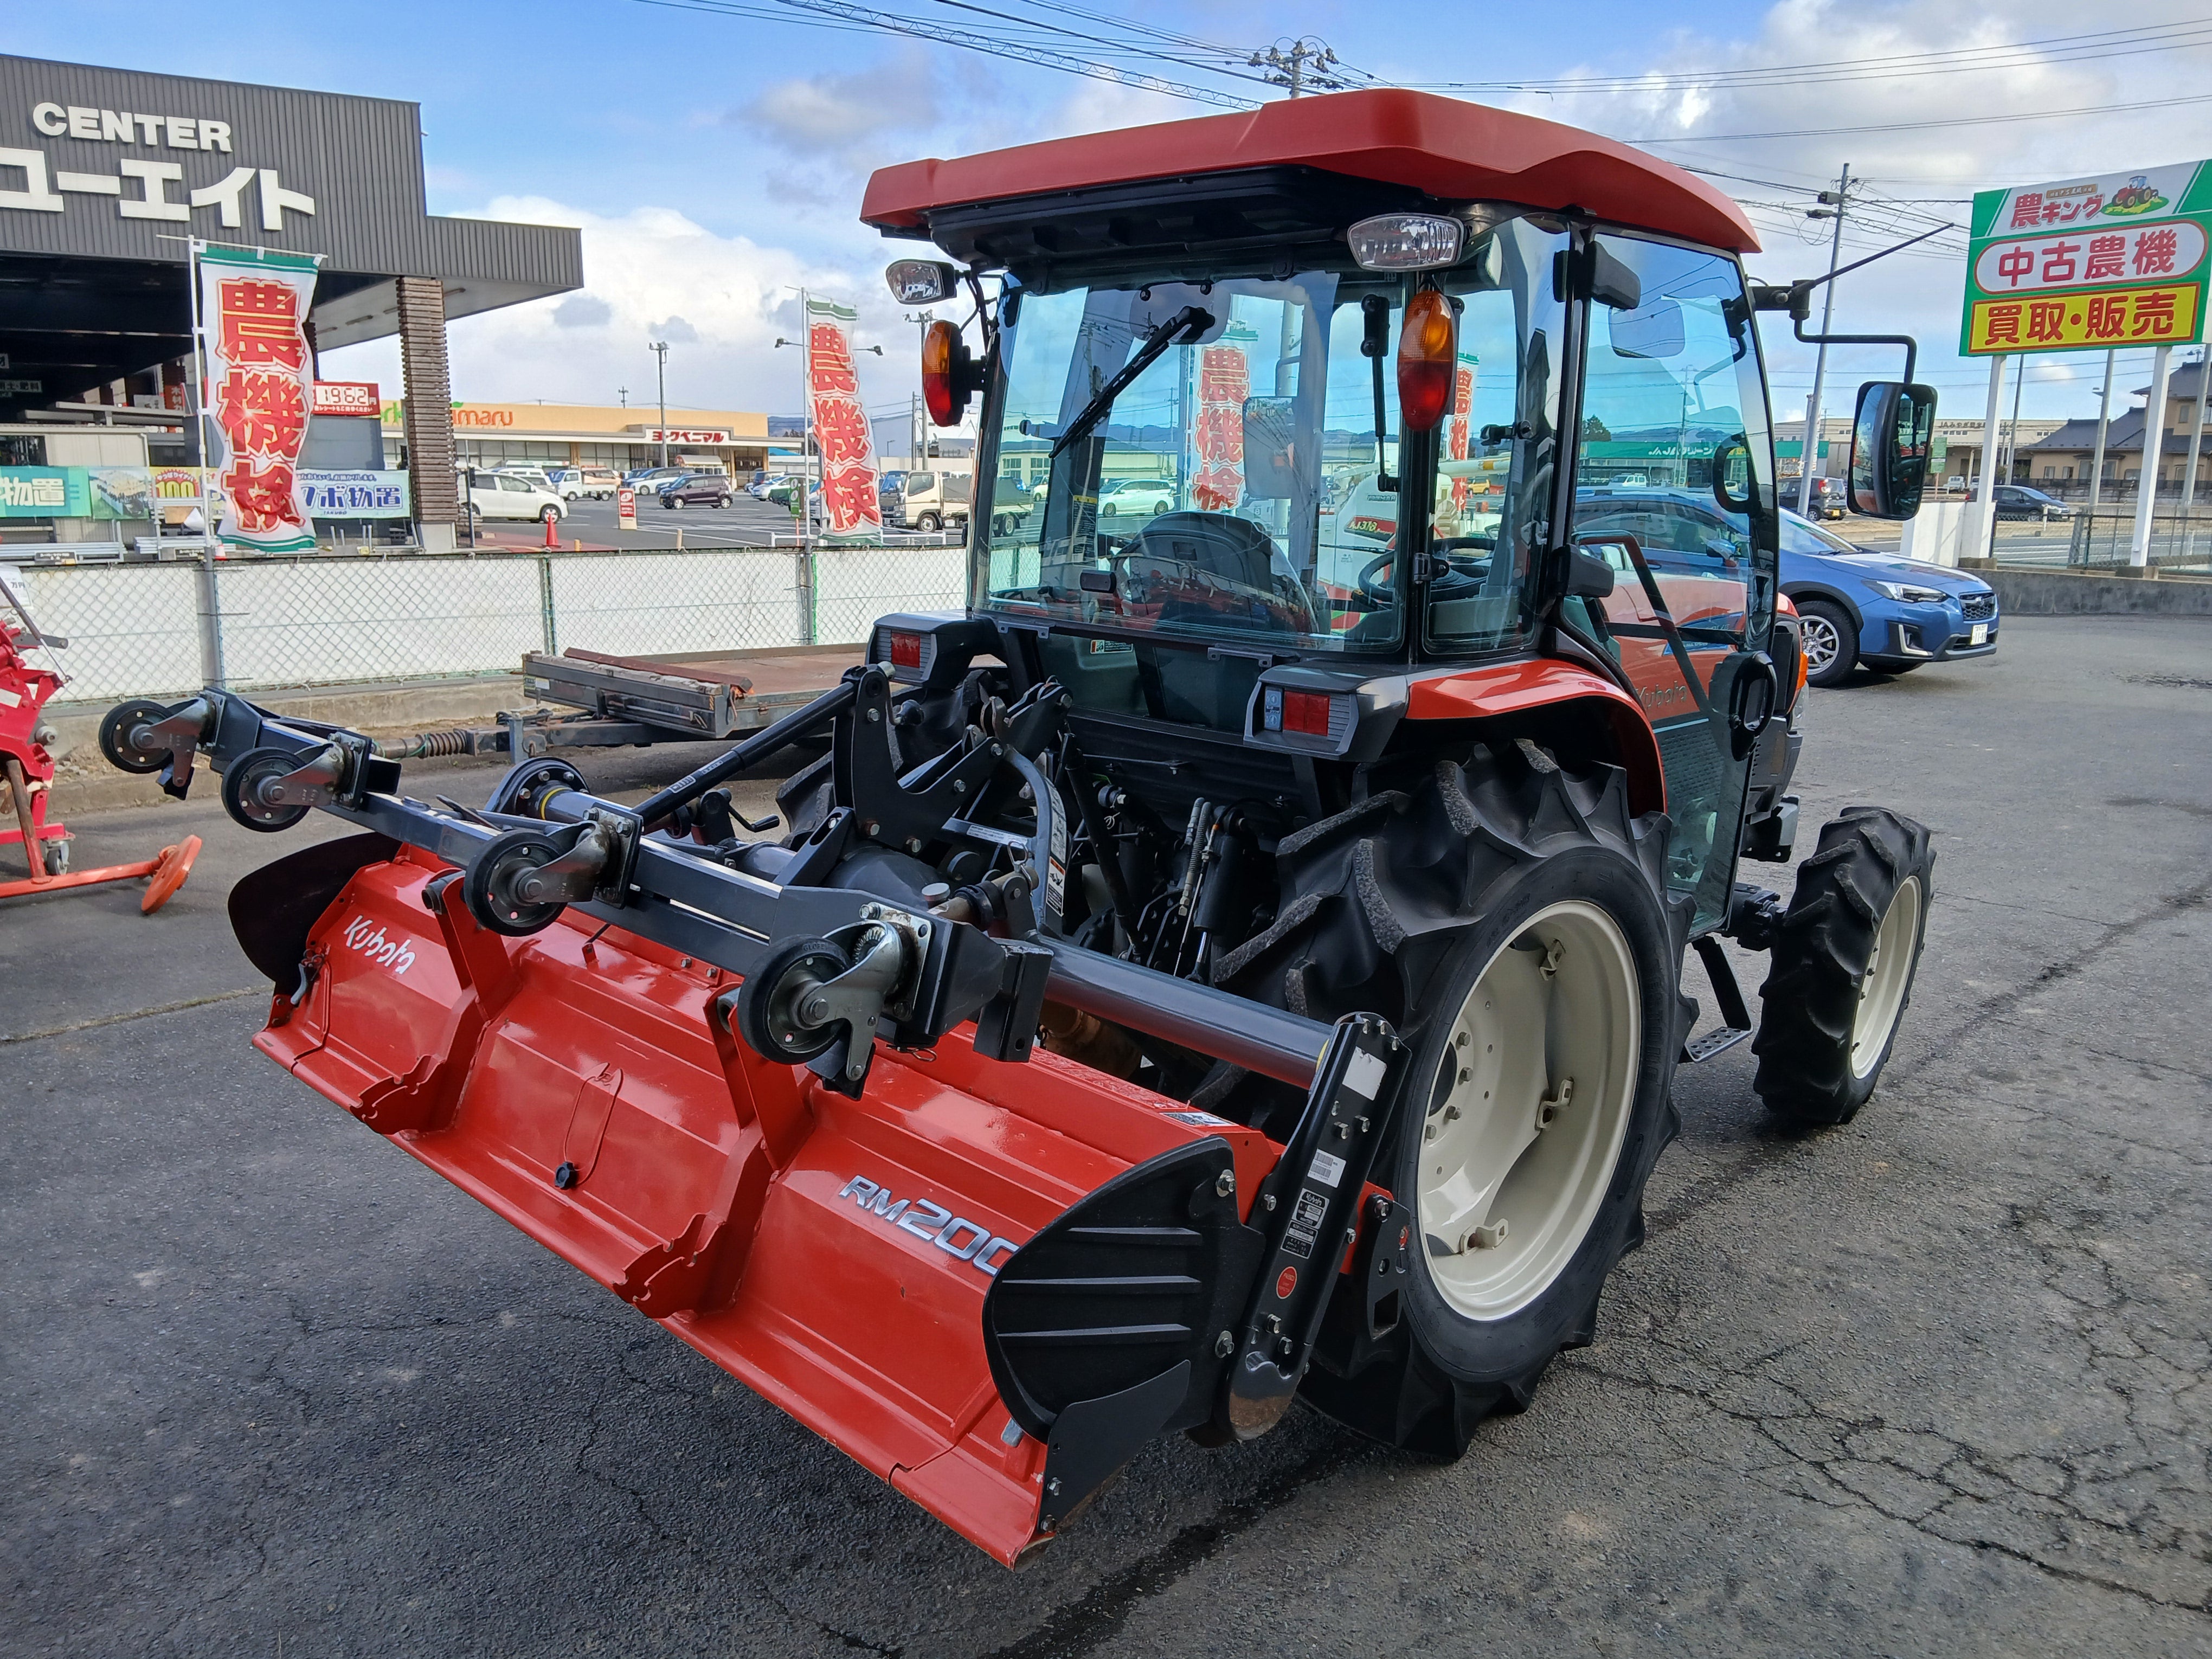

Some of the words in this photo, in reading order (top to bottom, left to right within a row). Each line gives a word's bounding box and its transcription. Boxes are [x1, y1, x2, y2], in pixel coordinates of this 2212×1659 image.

[33, 102, 233, 153] CENTER
[2010, 192, 2105, 229] 農キング
[1998, 228, 2177, 287] 中古農機
[1985, 292, 2177, 345] 買取・販売
[1636, 680, 1688, 708] Kubota
[344, 915, 415, 975] Kubota
